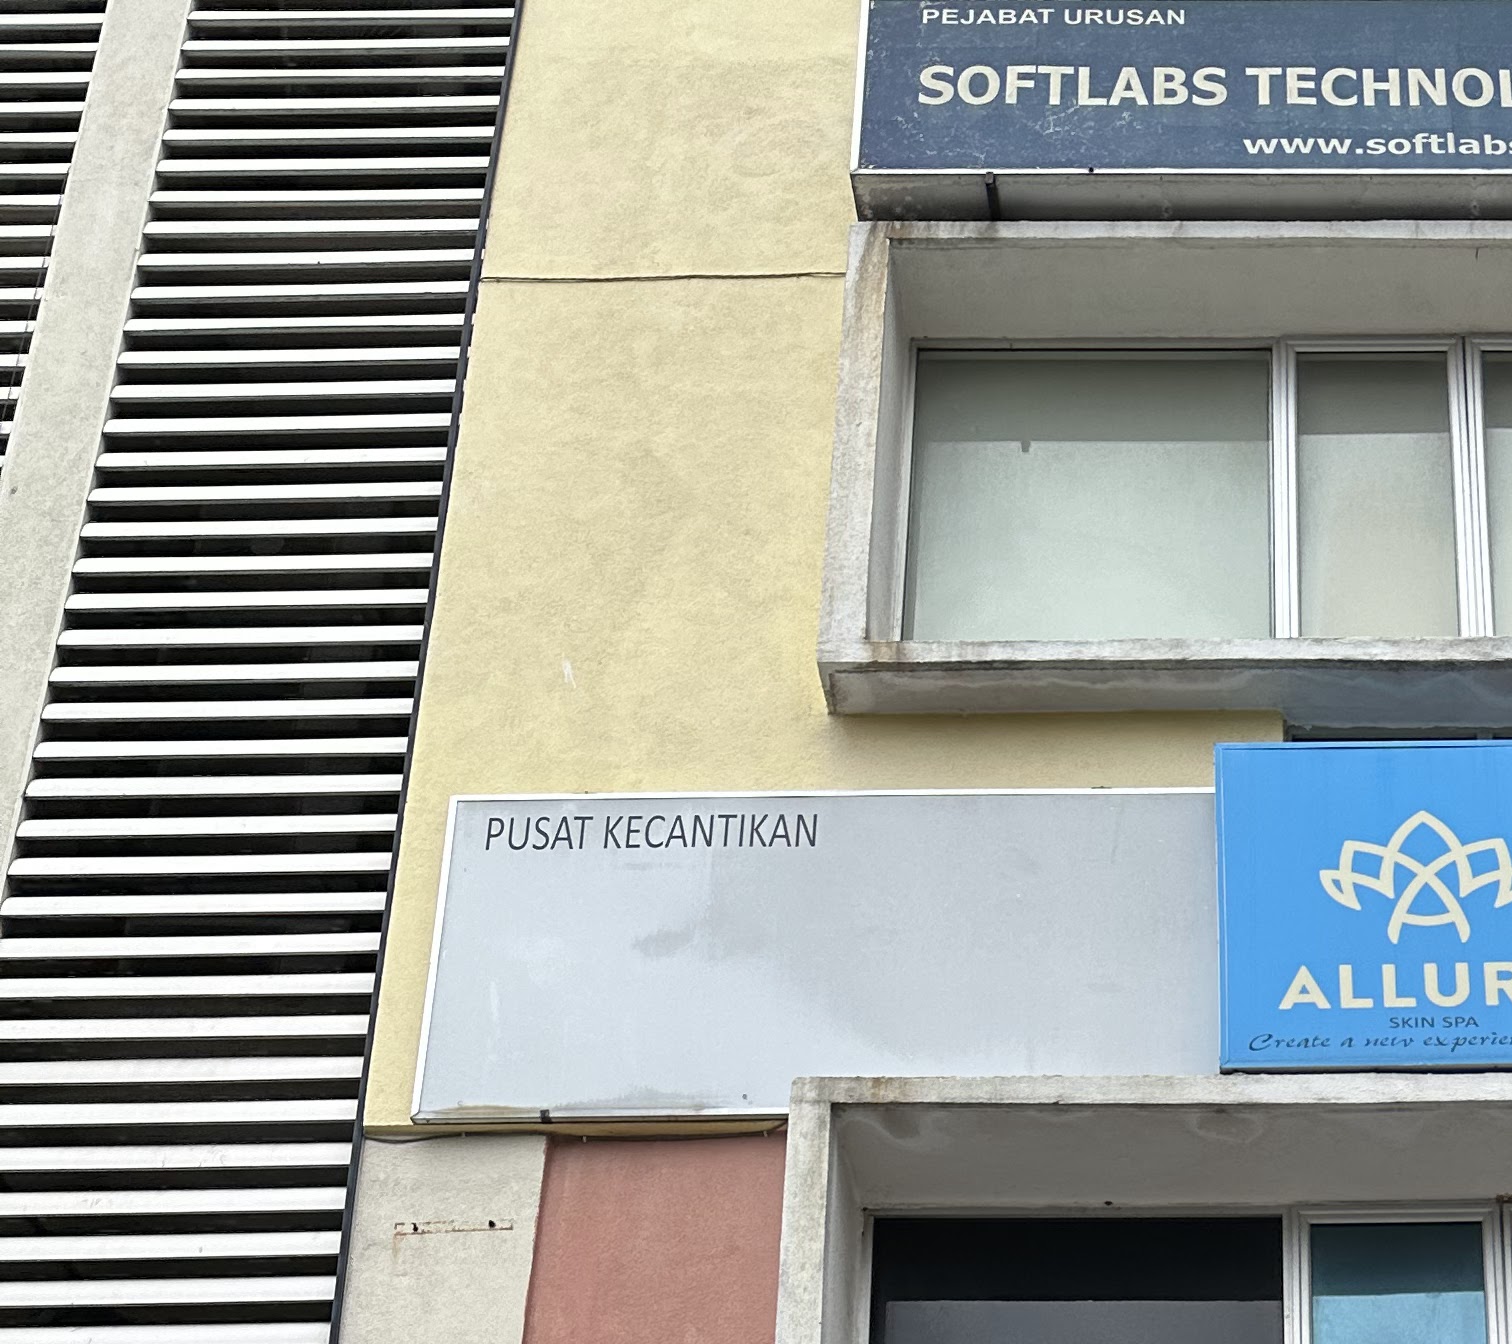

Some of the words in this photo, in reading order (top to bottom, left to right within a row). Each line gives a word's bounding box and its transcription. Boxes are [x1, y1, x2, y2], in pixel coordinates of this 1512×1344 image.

[921, 8, 1055, 26] PEJABAT
[1063, 8, 1186, 26] URUSAN
[917, 65, 1228, 108] SOFTLABS
[485, 816, 594, 851] PUSAT
[603, 813, 819, 849] KECANTIKAN
[1389, 1016, 1435, 1029] SKIN
[1443, 1016, 1480, 1028] SPA
[1248, 1032, 1331, 1053] Create
[1340, 1039, 1354, 1049] a
[1364, 1036, 1416, 1049] new
